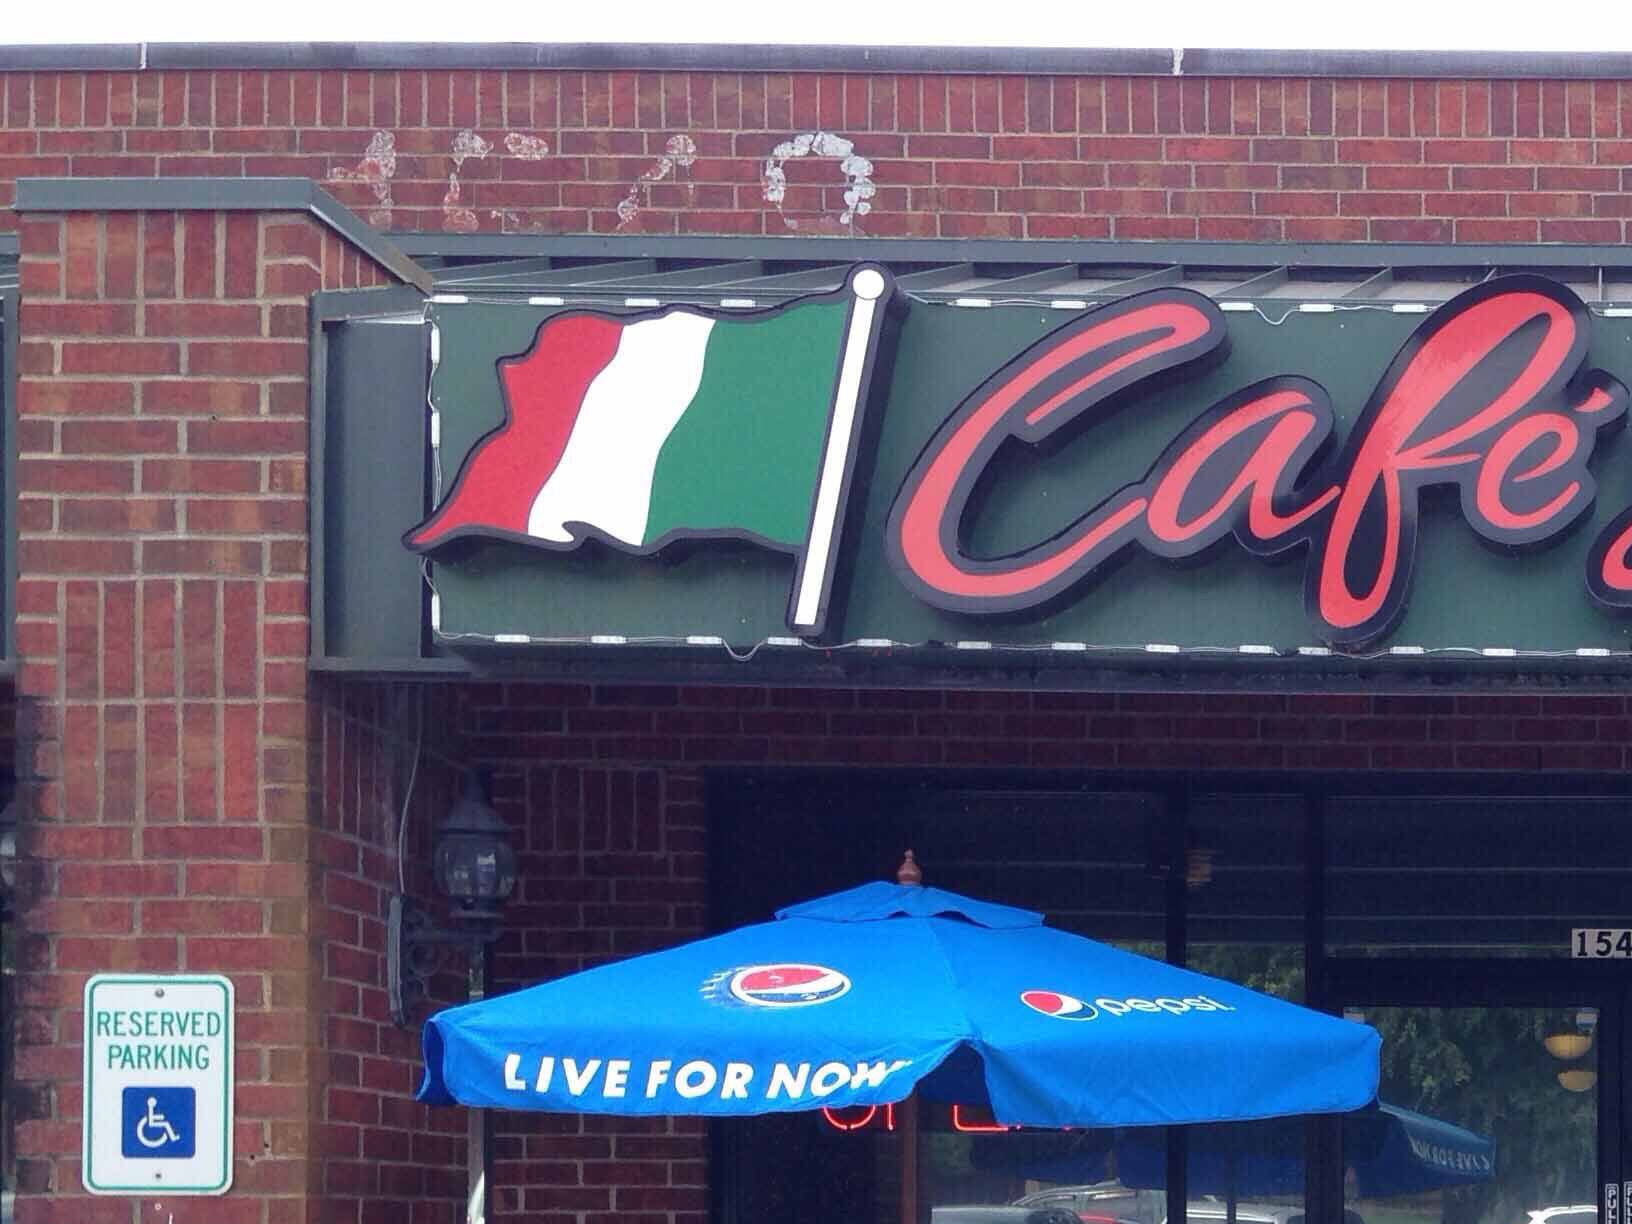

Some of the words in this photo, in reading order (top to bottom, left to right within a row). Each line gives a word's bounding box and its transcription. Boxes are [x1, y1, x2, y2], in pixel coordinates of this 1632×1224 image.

[901, 292, 1612, 628] Café
[1096, 995, 1236, 1016] pepsi
[96, 1010, 221, 1038] RESERVED
[107, 1044, 210, 1070] PARKING
[503, 1052, 631, 1098] LIVE
[645, 1059, 750, 1099] FOR
